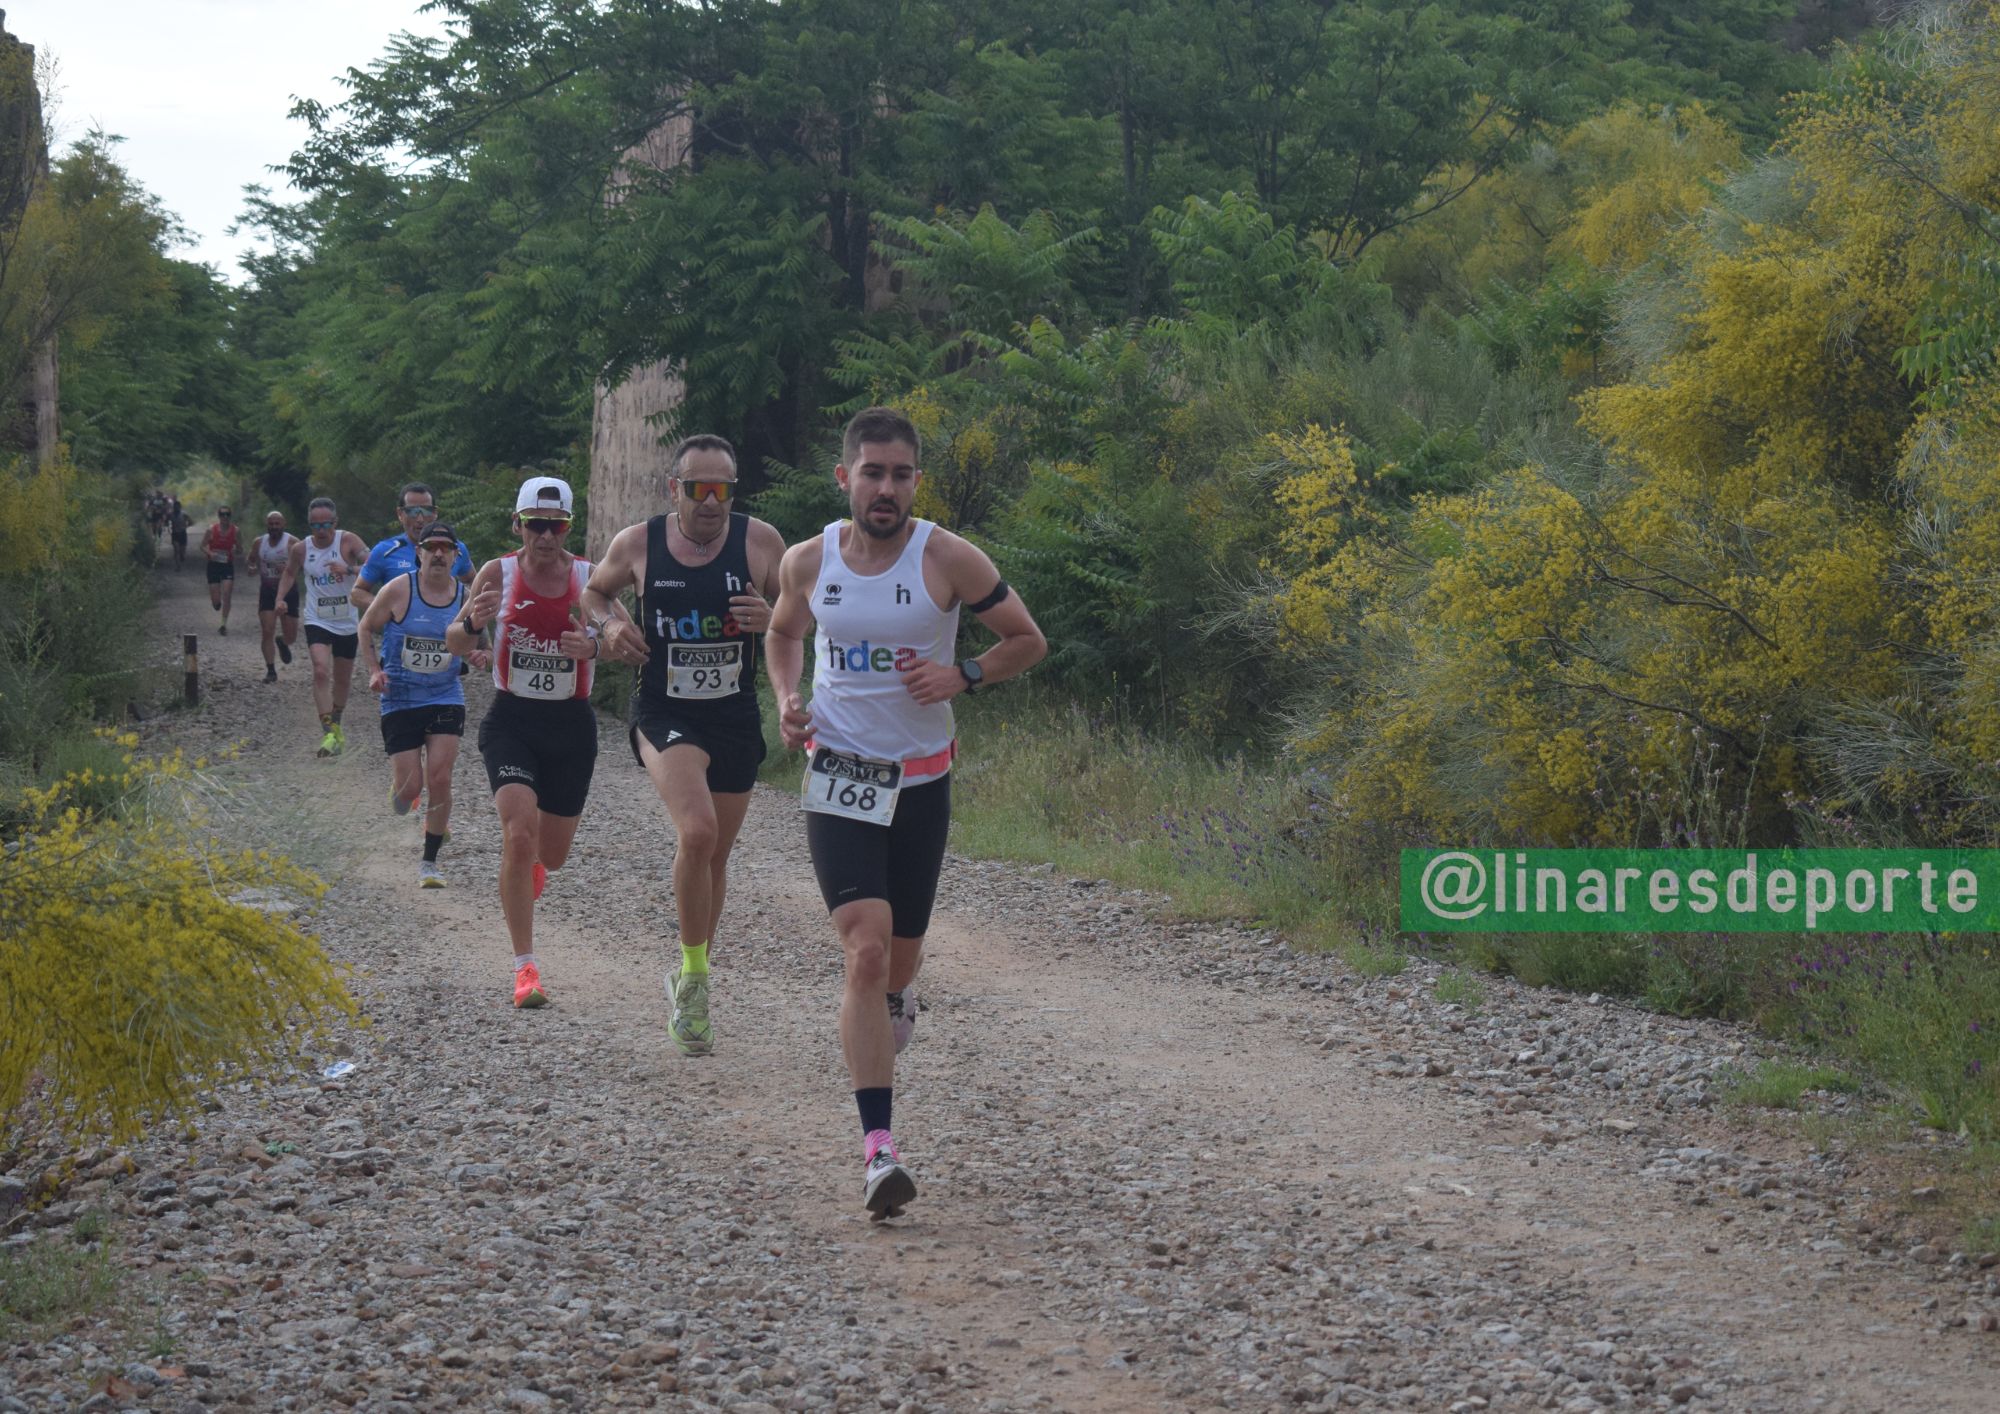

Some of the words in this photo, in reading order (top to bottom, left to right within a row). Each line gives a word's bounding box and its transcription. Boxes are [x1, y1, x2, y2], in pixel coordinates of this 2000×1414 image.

[896, 583, 911, 605] in
[411, 653, 442, 668] 219
[828, 637, 917, 672] indea
[528, 673, 555, 692] 48
[692, 668, 722, 689] 93
[826, 778, 877, 811] 168
